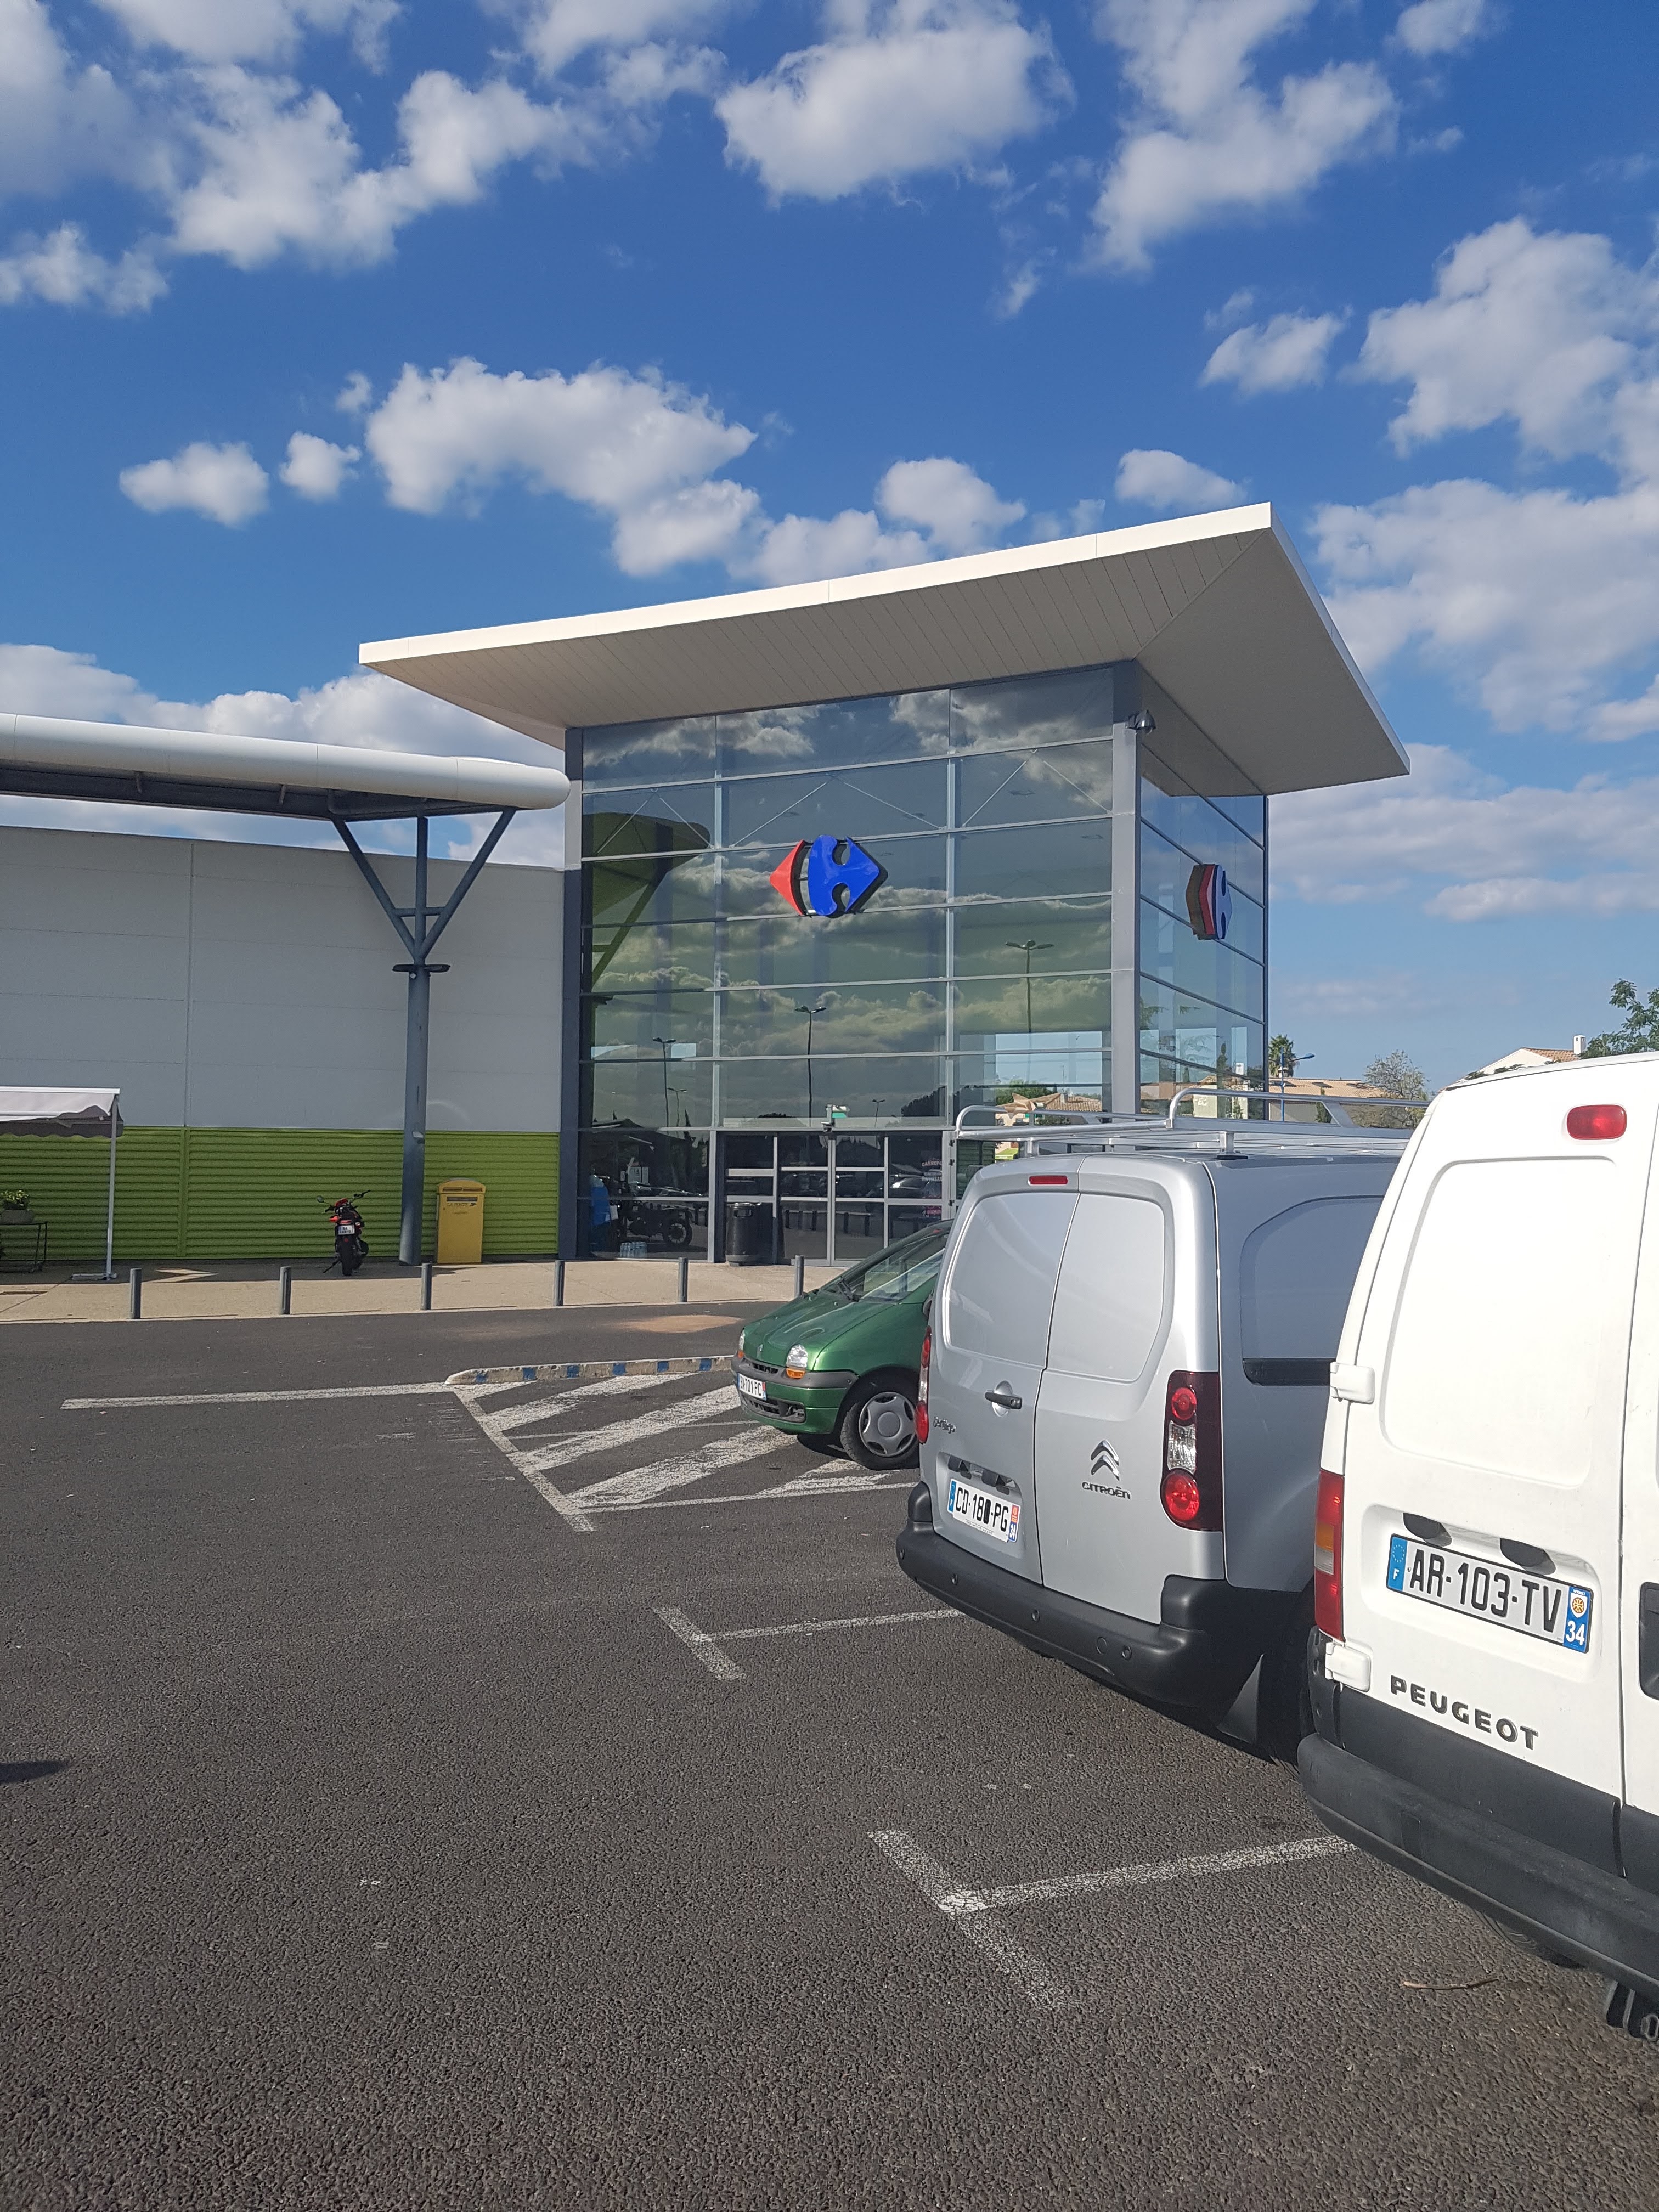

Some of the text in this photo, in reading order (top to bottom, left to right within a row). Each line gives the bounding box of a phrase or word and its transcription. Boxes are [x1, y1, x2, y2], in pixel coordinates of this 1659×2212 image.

[1393, 1568, 1400, 1580] F
[1409, 1549, 1562, 1633] AR-103-TV
[1566, 1620, 1585, 1646] 34
[1390, 1674, 1539, 1751] PEUGEOT
